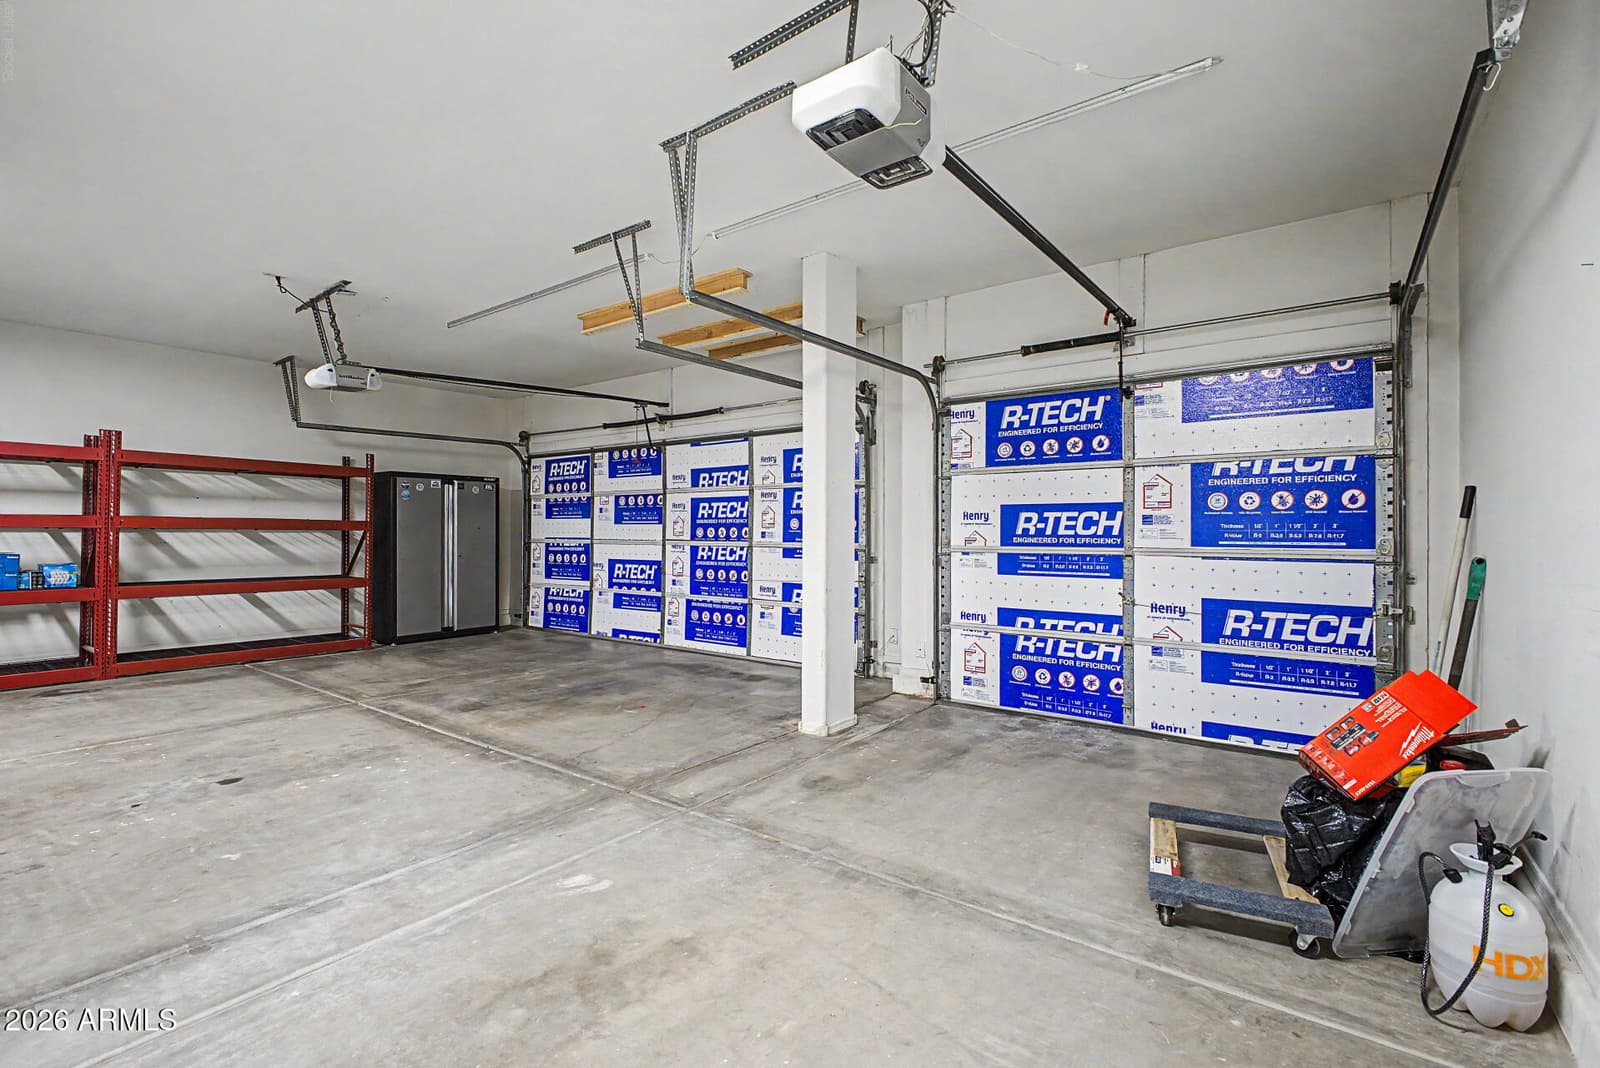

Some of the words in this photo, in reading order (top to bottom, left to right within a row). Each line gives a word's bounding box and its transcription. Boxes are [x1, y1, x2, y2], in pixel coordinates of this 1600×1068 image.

[998, 426, 1042, 437] ENGINEERED
[1060, 422, 1104, 433] EFFICIENCY
[698, 470, 749, 488] R-TECH
[1208, 477, 1268, 486] ENGINEERED
[1271, 476, 1292, 484] FOR
[1295, 474, 1357, 483] EFFICIENCY
[698, 501, 749, 518] R-TECH
[962, 511, 990, 522] Henry
[1015, 510, 1123, 536] R-TECH
[1076, 537, 1121, 545] EFFICIENCY
[697, 545, 748, 561] R-TECH
[960, 611, 987, 623] Henry
[1150, 603, 1186, 617] Henry
[1223, 608, 1372, 647] R-TECH
[1219, 638, 1281, 650] ENGINEERED
[1283, 643, 1305, 652] FOR
[1307, 645, 1371, 657] EFFICIENCY
[1012, 653, 1058, 665] ENGINEERED
[1059, 658, 1075, 667] FOR
[1076, 661, 1122, 672] EFFICIENCY
[1402, 726, 1435, 760] Milwaukee
[1472, 944, 1547, 981] HDX
